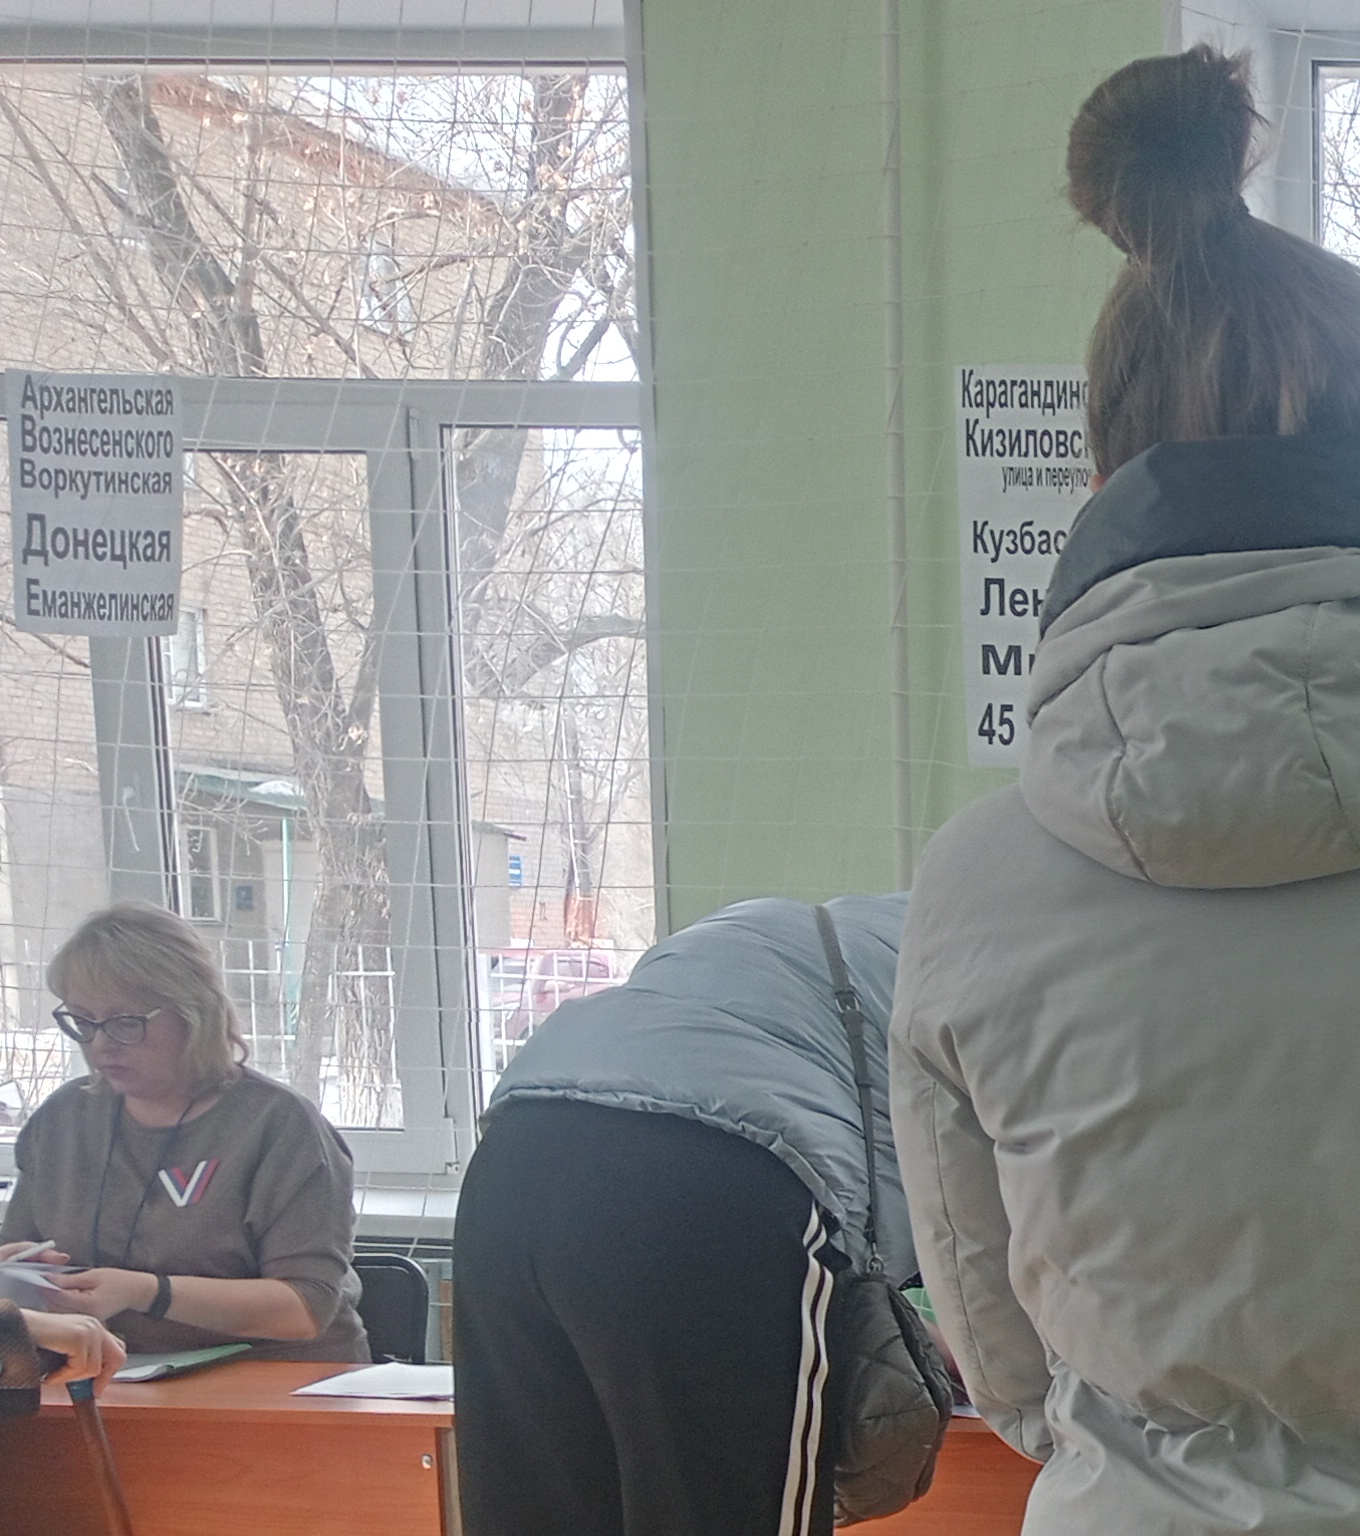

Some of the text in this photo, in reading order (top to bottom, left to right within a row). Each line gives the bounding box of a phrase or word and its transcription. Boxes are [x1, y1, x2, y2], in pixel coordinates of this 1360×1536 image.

[21, 374, 174, 419] Архангельская
[21, 414, 174, 459] Вознесенского
[965, 418, 1089, 459] Кизиловс
[20, 458, 172, 500] Воркутинская
[1002, 466, 1090, 494] улица и переуло
[22, 513, 171, 570] Донецкая
[26, 578, 175, 622] Еманжелинская
[978, 703, 1015, 746] 45
